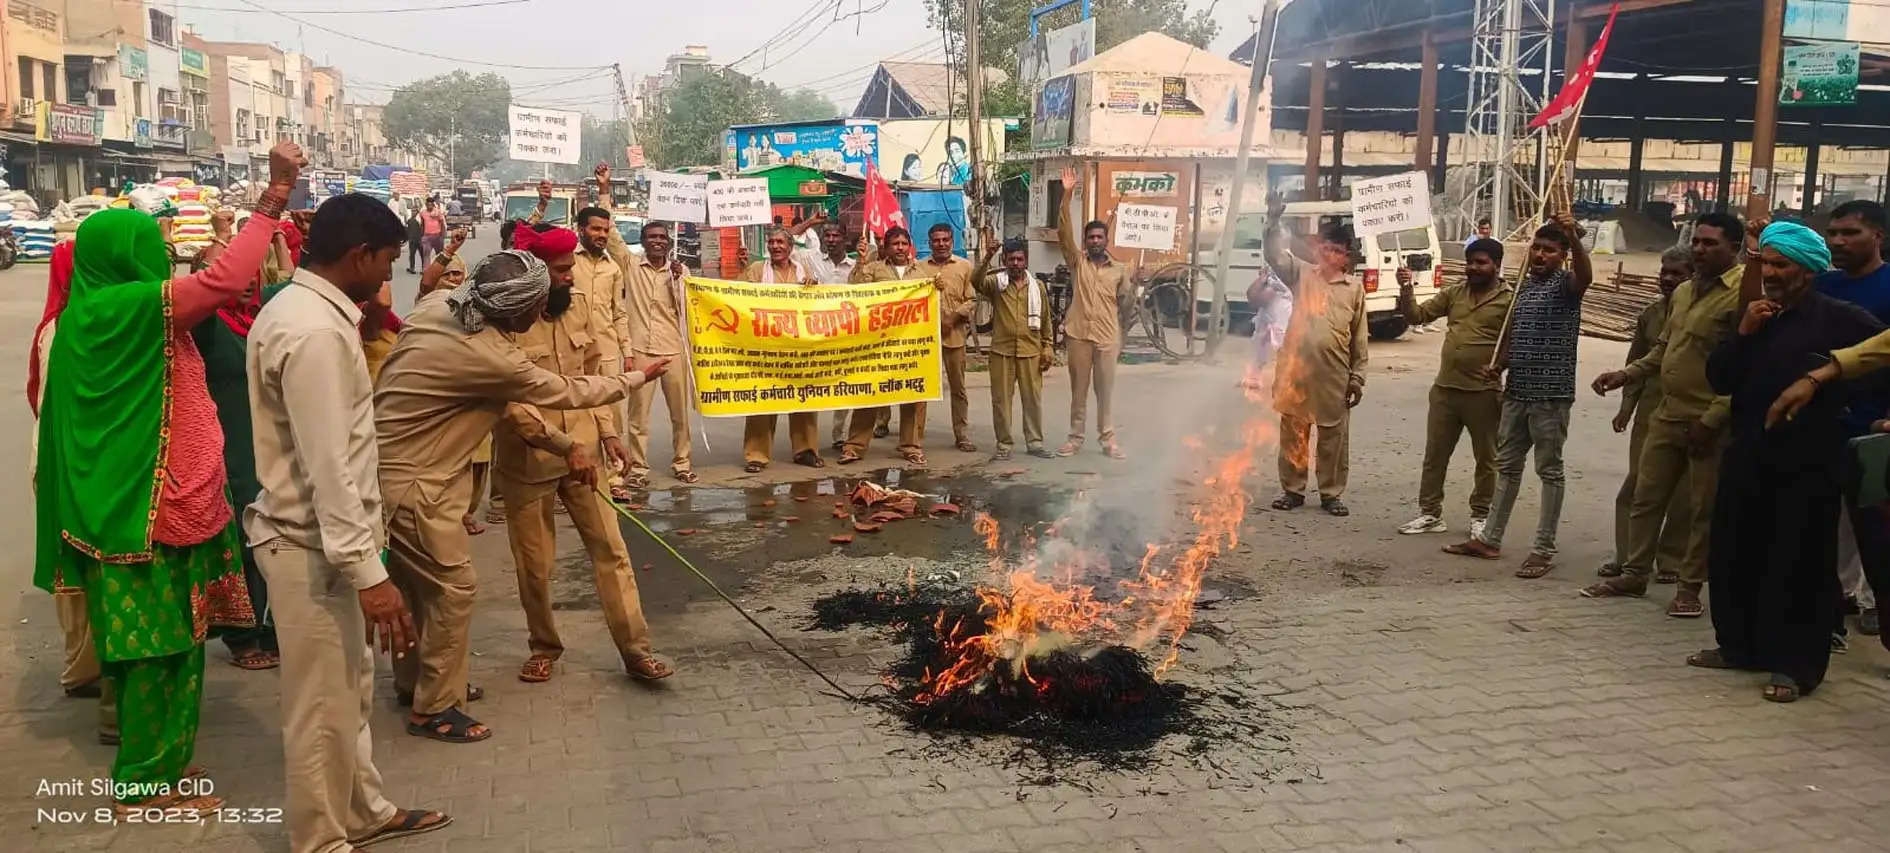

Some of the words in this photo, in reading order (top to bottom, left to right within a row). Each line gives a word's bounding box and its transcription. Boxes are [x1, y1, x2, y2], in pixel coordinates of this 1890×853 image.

[1387, 176, 1412, 190] सफाई
[750, 307, 799, 339] राज्य
[802, 301, 860, 337] व्यापी
[866, 296, 930, 339] हड़ताल
[701, 387, 731, 403] ग्रामीण
[733, 385, 757, 402] सफाई
[760, 384, 795, 400] कर्मचारी
[833, 381, 876, 397] हरियाणा,
[878, 377, 904, 393] ब्लॉक
